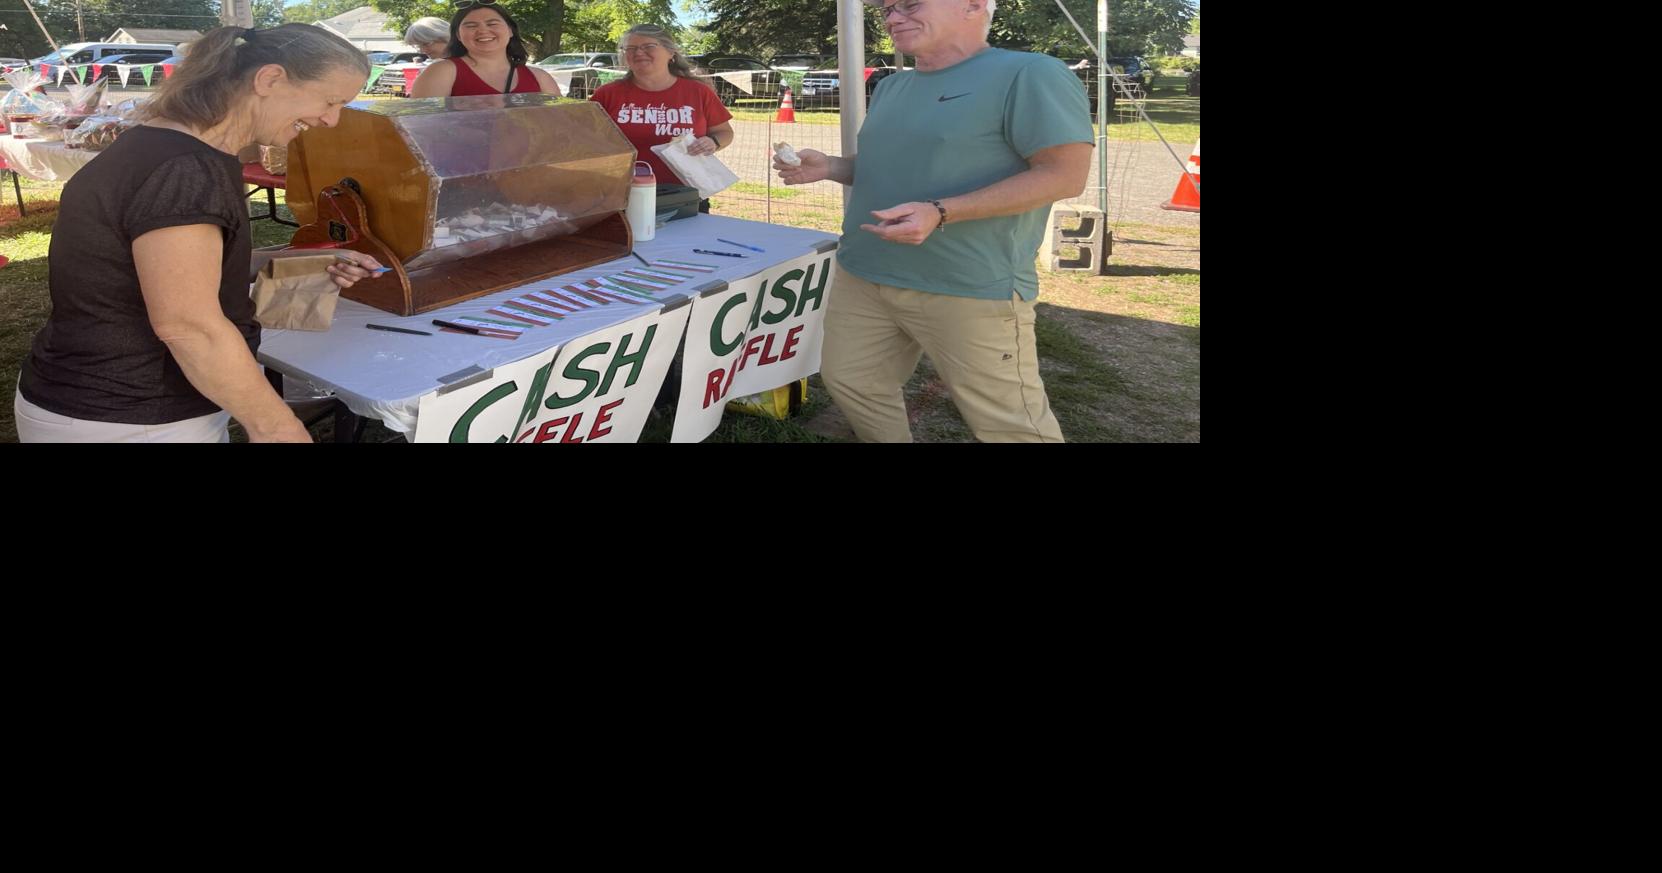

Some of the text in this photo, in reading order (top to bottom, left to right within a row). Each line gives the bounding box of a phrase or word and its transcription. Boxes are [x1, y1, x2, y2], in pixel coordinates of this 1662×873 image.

[655, 123, 695, 136] Mom
[710, 257, 831, 357] CASH
[449, 323, 658, 443] CASH
[702, 324, 805, 409] RFLE
